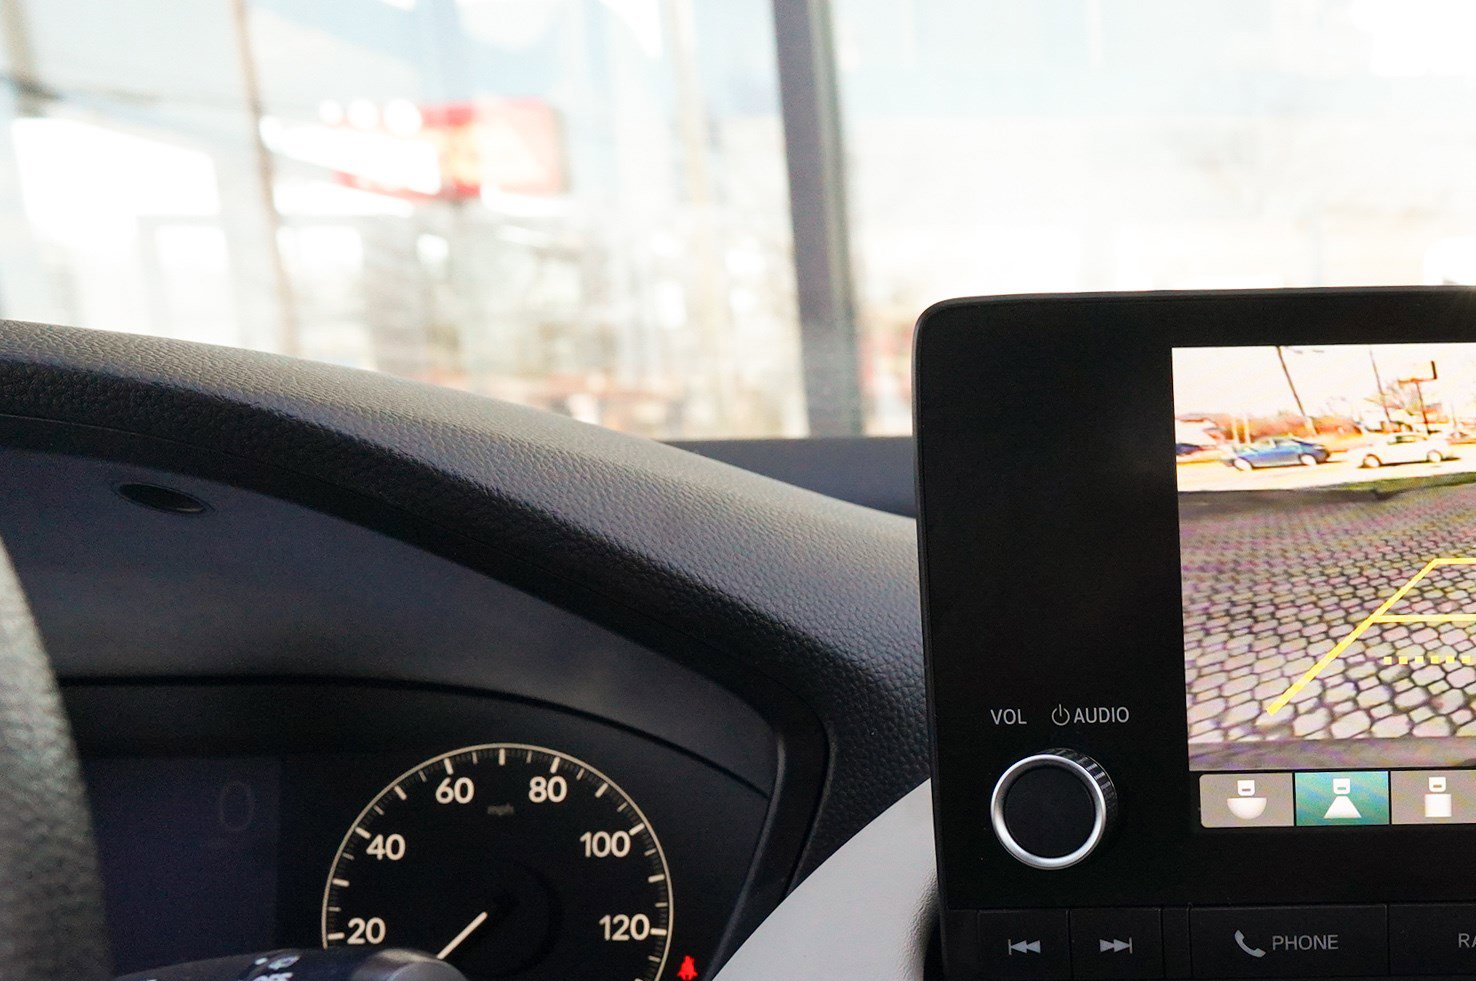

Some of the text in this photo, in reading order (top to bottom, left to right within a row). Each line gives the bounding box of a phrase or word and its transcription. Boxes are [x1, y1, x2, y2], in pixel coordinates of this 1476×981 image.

[991, 706, 1130, 725] VOL AUDIO
[435, 777, 474, 804] 60
[528, 776, 567, 803] 80
[366, 834, 406, 860] 40
[579, 830, 631, 858] 100
[347, 917, 386, 945] 20
[599, 913, 650, 941] 120
[1272, 934, 1339, 951] PHONE
